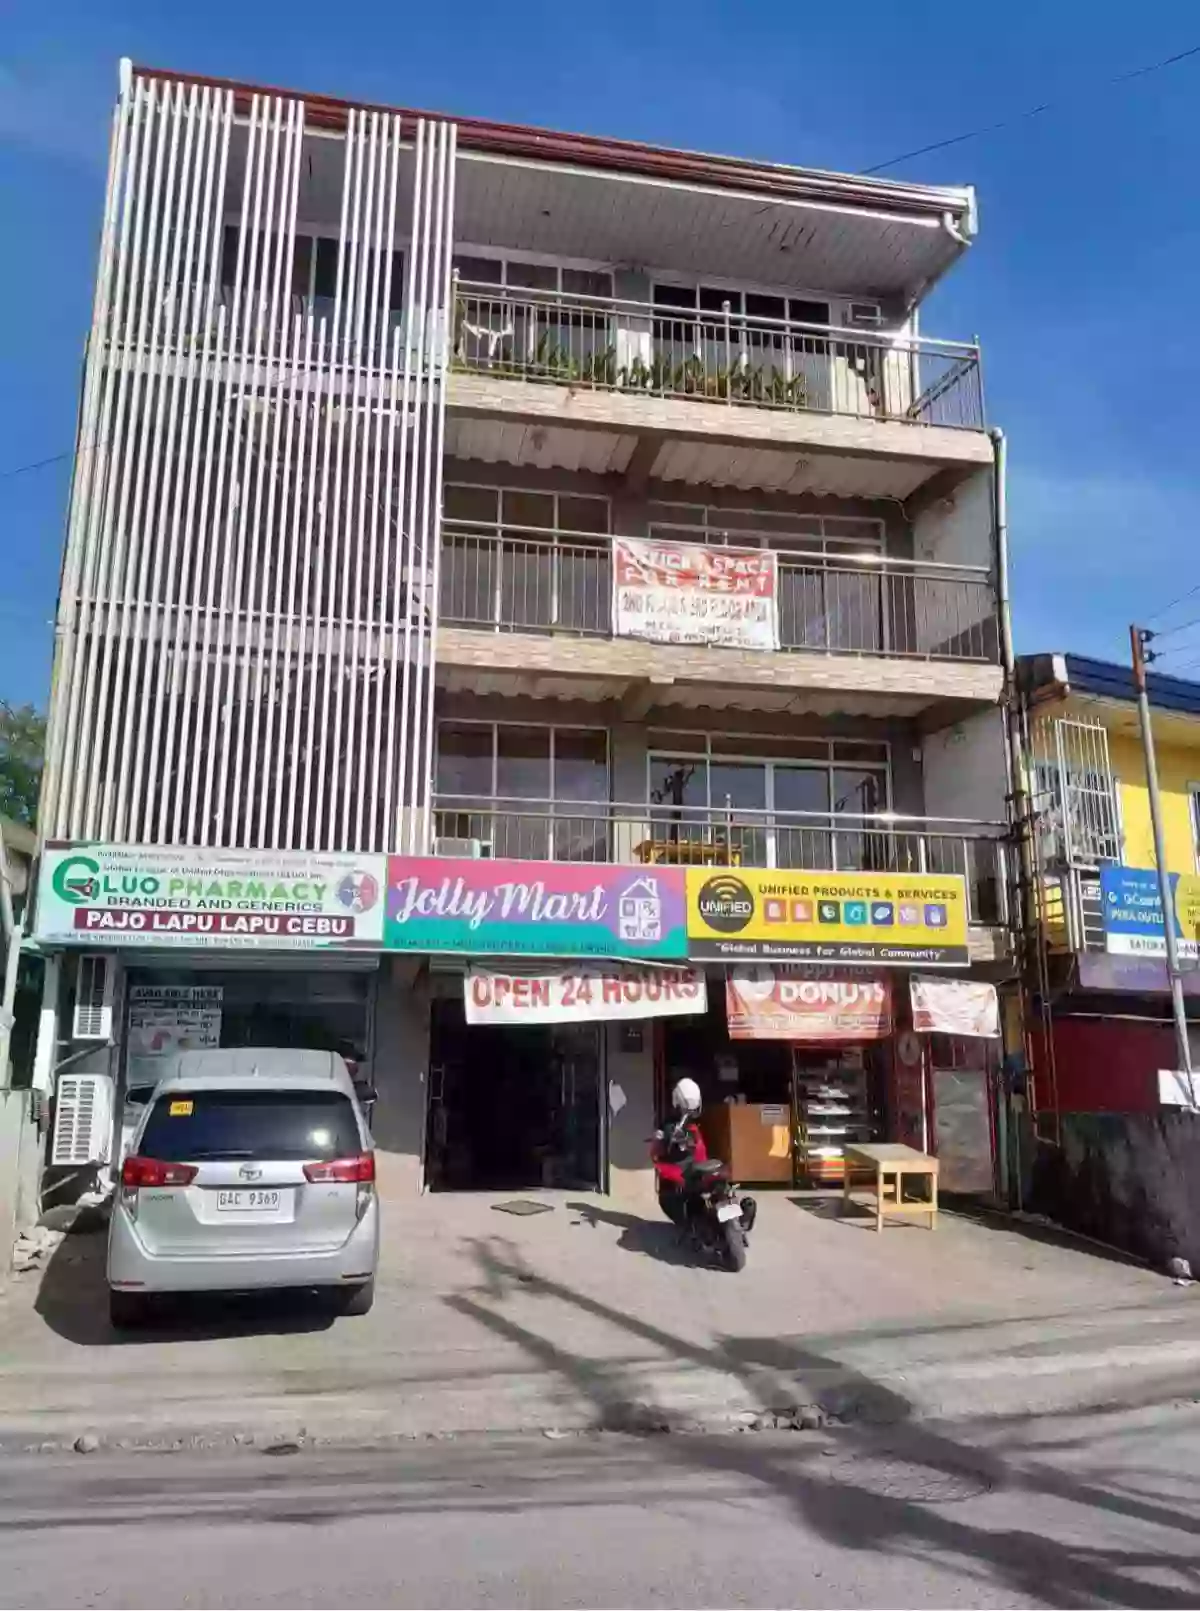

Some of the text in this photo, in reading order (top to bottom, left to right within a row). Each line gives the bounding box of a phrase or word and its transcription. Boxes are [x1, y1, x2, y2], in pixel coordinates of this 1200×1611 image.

[168, 877, 326, 900] PHARMACY
[758, 883, 809, 896] UNIFIED
[813, 886, 880, 898] PRODUCTS
[897, 890, 957, 901] SERVICES
[107, 895, 323, 912] BRANDED AND GENERICS
[396, 876, 608, 930] Jolly Mart
[700, 900, 752, 913] UNIFIED
[86, 910, 347, 934] PAJO LAPU LAPU CEBU
[763, 943, 811, 955] Business
[817, 945, 836, 956] for
[840, 945, 875, 957] Global
[472, 967, 700, 1008] OPEN 24 HOURS
[780, 982, 886, 1004] DONUTS
